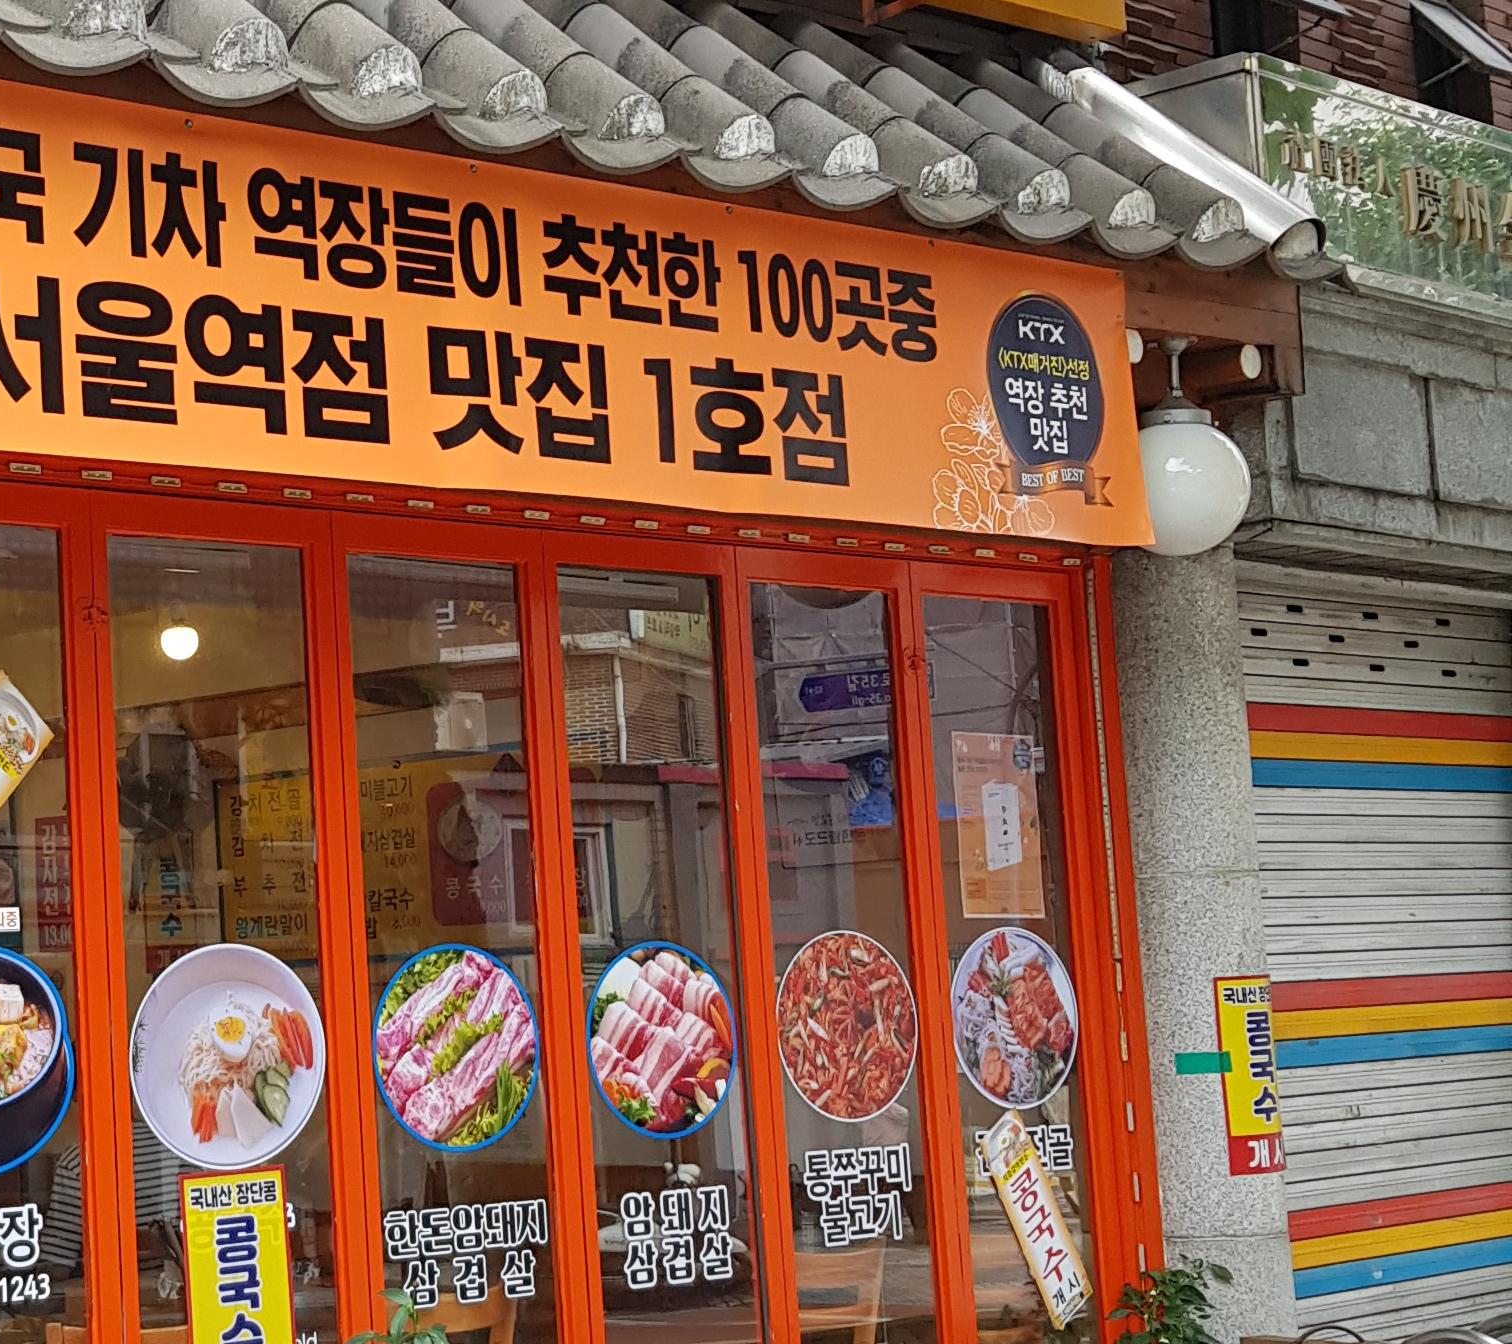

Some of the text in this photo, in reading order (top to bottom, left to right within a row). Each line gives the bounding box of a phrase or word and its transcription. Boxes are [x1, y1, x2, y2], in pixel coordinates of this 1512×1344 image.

[73, 141, 226, 268] 기차
[247, 166, 522, 307] 역장들이
[542, 213, 721, 332] 추천한
[737, 250, 938, 363] 100곳중
[1018, 319, 1065, 345] KTX
[426, 325, 613, 465] 맛집
[643, 357, 851, 487] 1호점
[1004, 376, 1088, 421] 역장 추천
[1029, 417, 1069, 455] 맛집
[1021, 467, 1085, 487] BEST OF BEST
[1246, 1010, 1278, 1124] 콩국수
[190, 1179, 278, 1210] 국내산 장단콩
[804, 1142, 913, 1204] 통쭈꾸미
[384, 1199, 548, 1260] 한돈암돼지
[620, 1184, 730, 1241] 암돼지
[819, 1191, 905, 1249] 불고기
[1009, 1166, 1069, 1282] 콩국수
[404, 1250, 537, 1311] 삼겹살
[624, 1231, 733, 1290] 삼겹살
